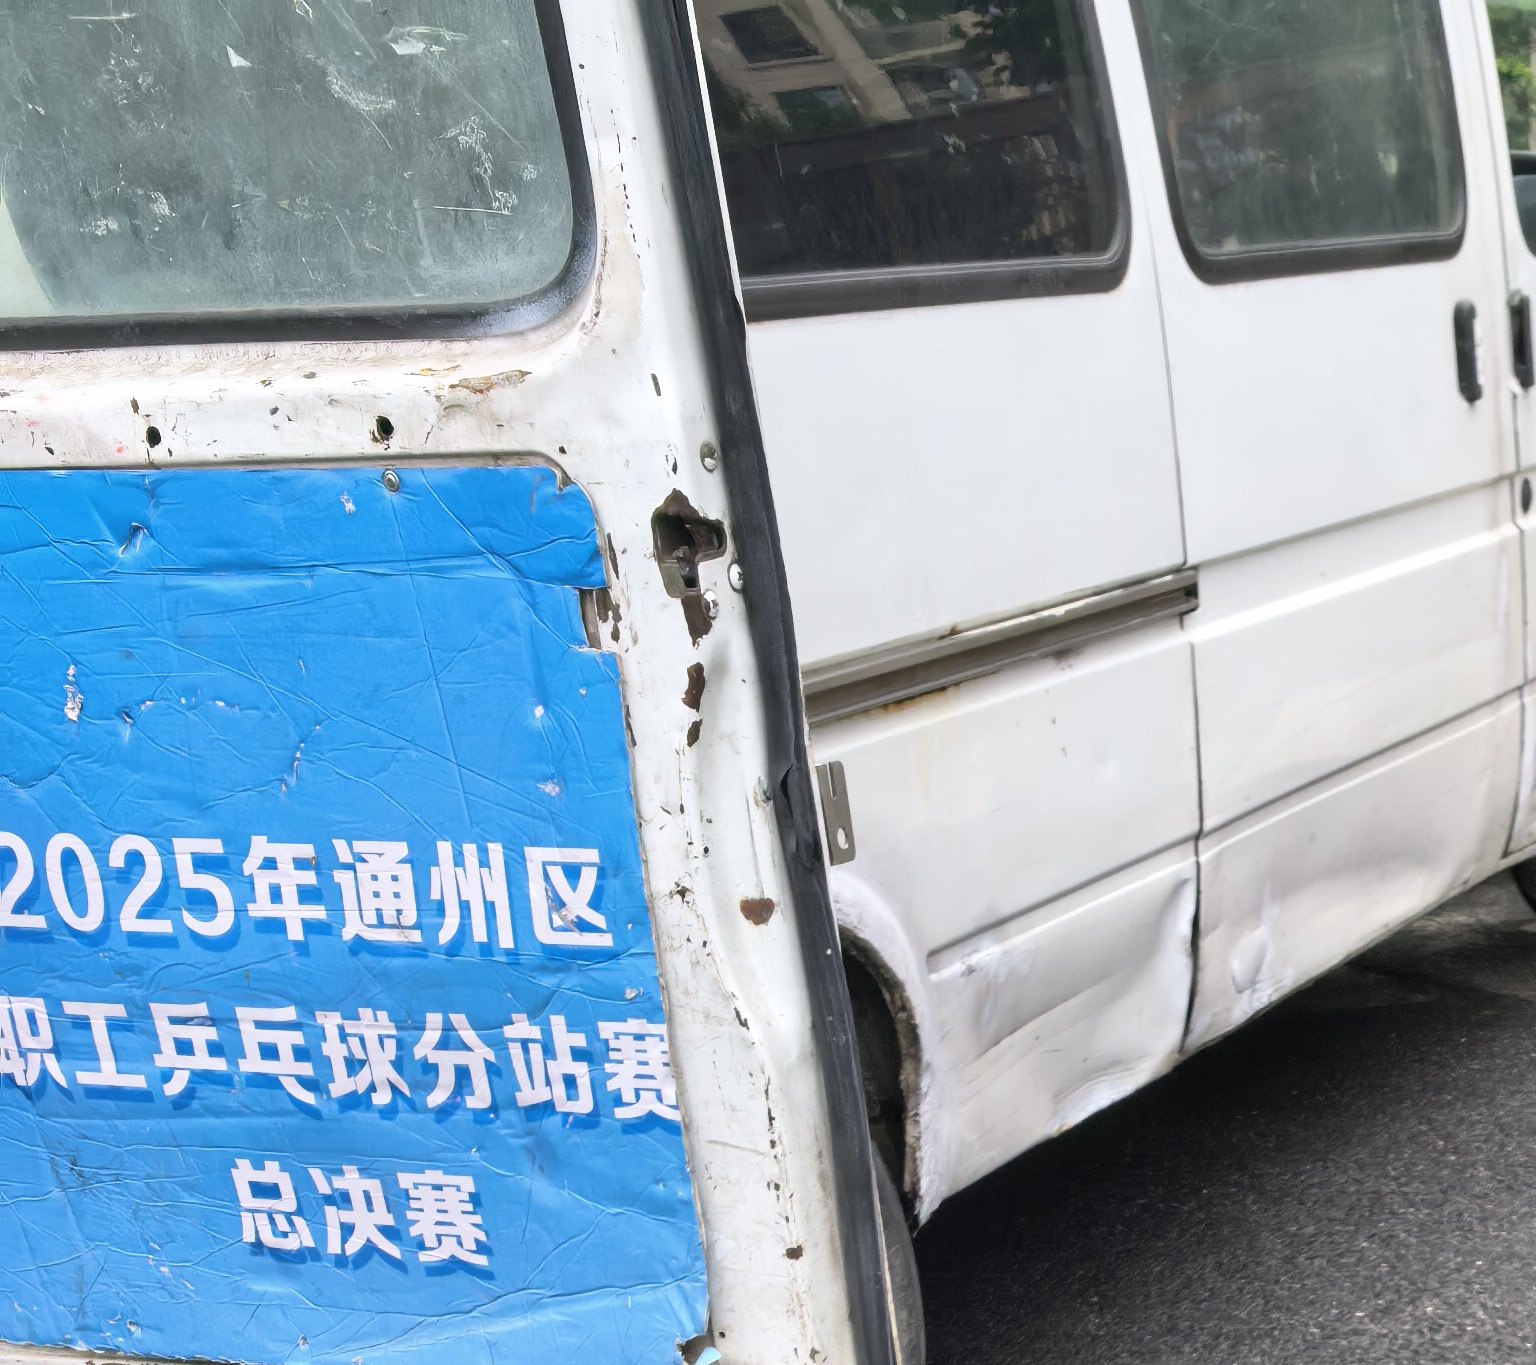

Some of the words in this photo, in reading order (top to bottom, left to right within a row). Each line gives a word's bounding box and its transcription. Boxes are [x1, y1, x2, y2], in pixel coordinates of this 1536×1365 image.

[0, 831, 613, 949] 2025年通州区
[0, 996, 682, 1122] 职工乒乓球分站赛
[231, 1158, 489, 1267] 总决赛
